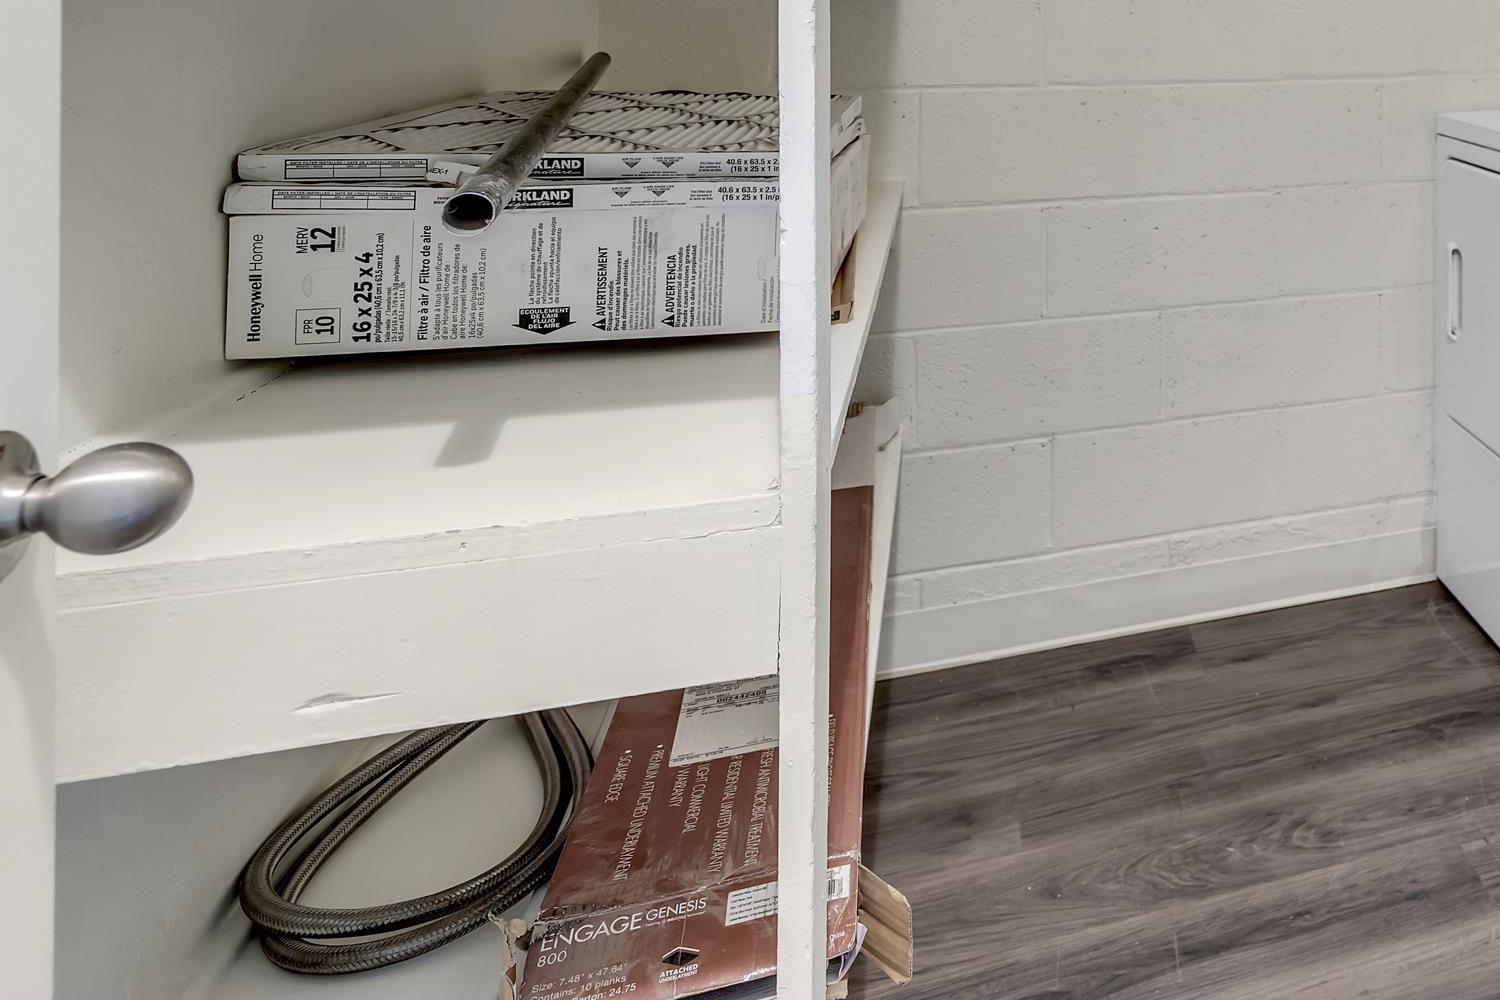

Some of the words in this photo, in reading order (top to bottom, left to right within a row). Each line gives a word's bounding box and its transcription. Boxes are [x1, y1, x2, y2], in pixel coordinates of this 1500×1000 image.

[534, 159, 582, 170] KLAND
[513, 190, 571, 201] RKLAND
[742, 193, 751, 201] 25
[296, 226, 309, 254] MERV
[309, 226, 337, 253] 12
[422, 225, 432, 244] aire
[249, 234, 264, 272] Home
[355, 251, 374, 264] 4
[420, 244, 431, 257] de
[359, 266, 374, 278] x
[419, 258, 431, 285] Filtro
[596, 246, 608, 317] AVERTISSEMENT
[665, 254, 677, 313] ADVERTENCIA
[353, 281, 374, 304] 25
[419, 293, 430, 305] air
[247, 273, 265, 343] Honeywell
[358, 307, 373, 319] x
[303, 319, 314, 335] FPR
[315, 316, 335, 336] 10
[352, 322, 372, 344] 16
[417, 315, 429, 341] Filtre
[611, 754, 633, 781] SQUARE
[646, 749, 665, 776] PREMIUM
[695, 764, 710, 782] LIGHT
[604, 778, 625, 804] EDGE
[668, 766, 690, 808] WARRANTY
[724, 759, 743, 801] RESIDENTIAL
[632, 773, 659, 818] ATTACHED
[751, 767, 773, 823] ANTIMICROBIAL
[681, 783, 707, 835] COMMERCIAL
[716, 799, 735, 828] LIMITED
[612, 814, 646, 881] UNDERLAYMENT
[708, 827, 729, 873] WARRANTY
[744, 820, 764, 867] TREATMENT
[540, 912, 643, 953] ENGAGE
[645, 897, 708, 922] GENESIS
[536, 950, 568, 969] 800
[659, 963, 699, 978] ATTACHED
[531, 981, 557, 994] Size:
[580, 983, 592, 992] 10
[593, 976, 627, 991] planks
[608, 983, 637, 997] 24.75
